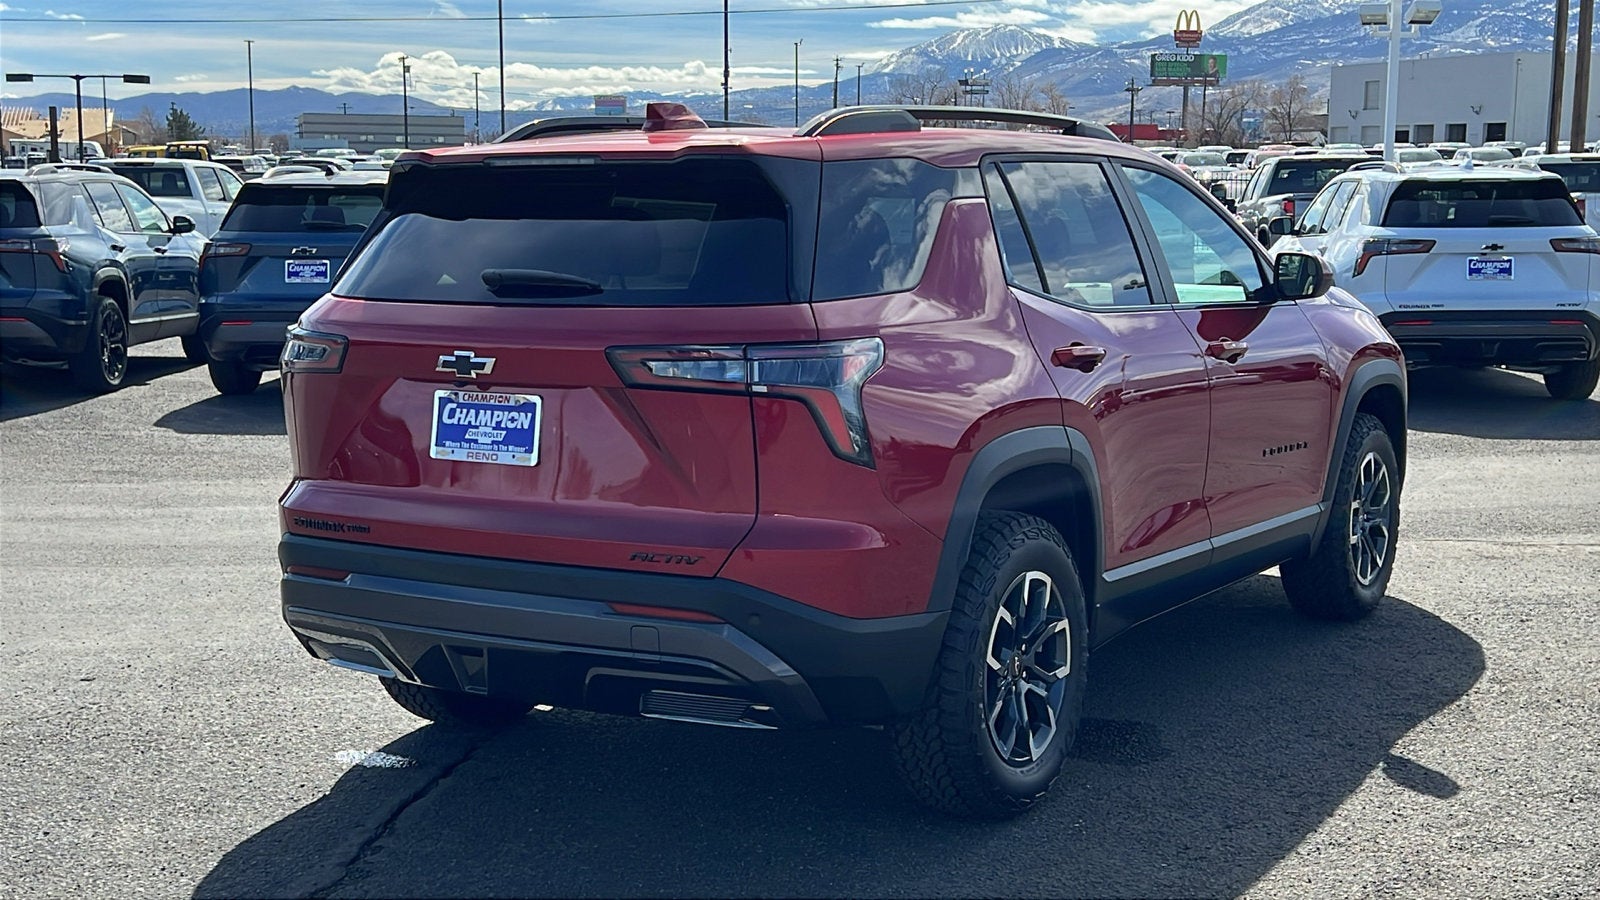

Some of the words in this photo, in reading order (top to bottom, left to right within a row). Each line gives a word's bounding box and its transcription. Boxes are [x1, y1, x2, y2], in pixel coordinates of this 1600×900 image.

[1155, 54, 1176, 62] GREG
[1176, 54, 1195, 62] KIDD
[462, 393, 511, 404] CHAMPION
[442, 403, 532, 429] CHAMPION
[467, 430, 504, 439] CHEVROLET
[461, 441, 470, 449] The
[470, 442, 493, 451] Customer
[466, 451, 499, 461] RENO
[629, 552, 705, 565] ACTIV
